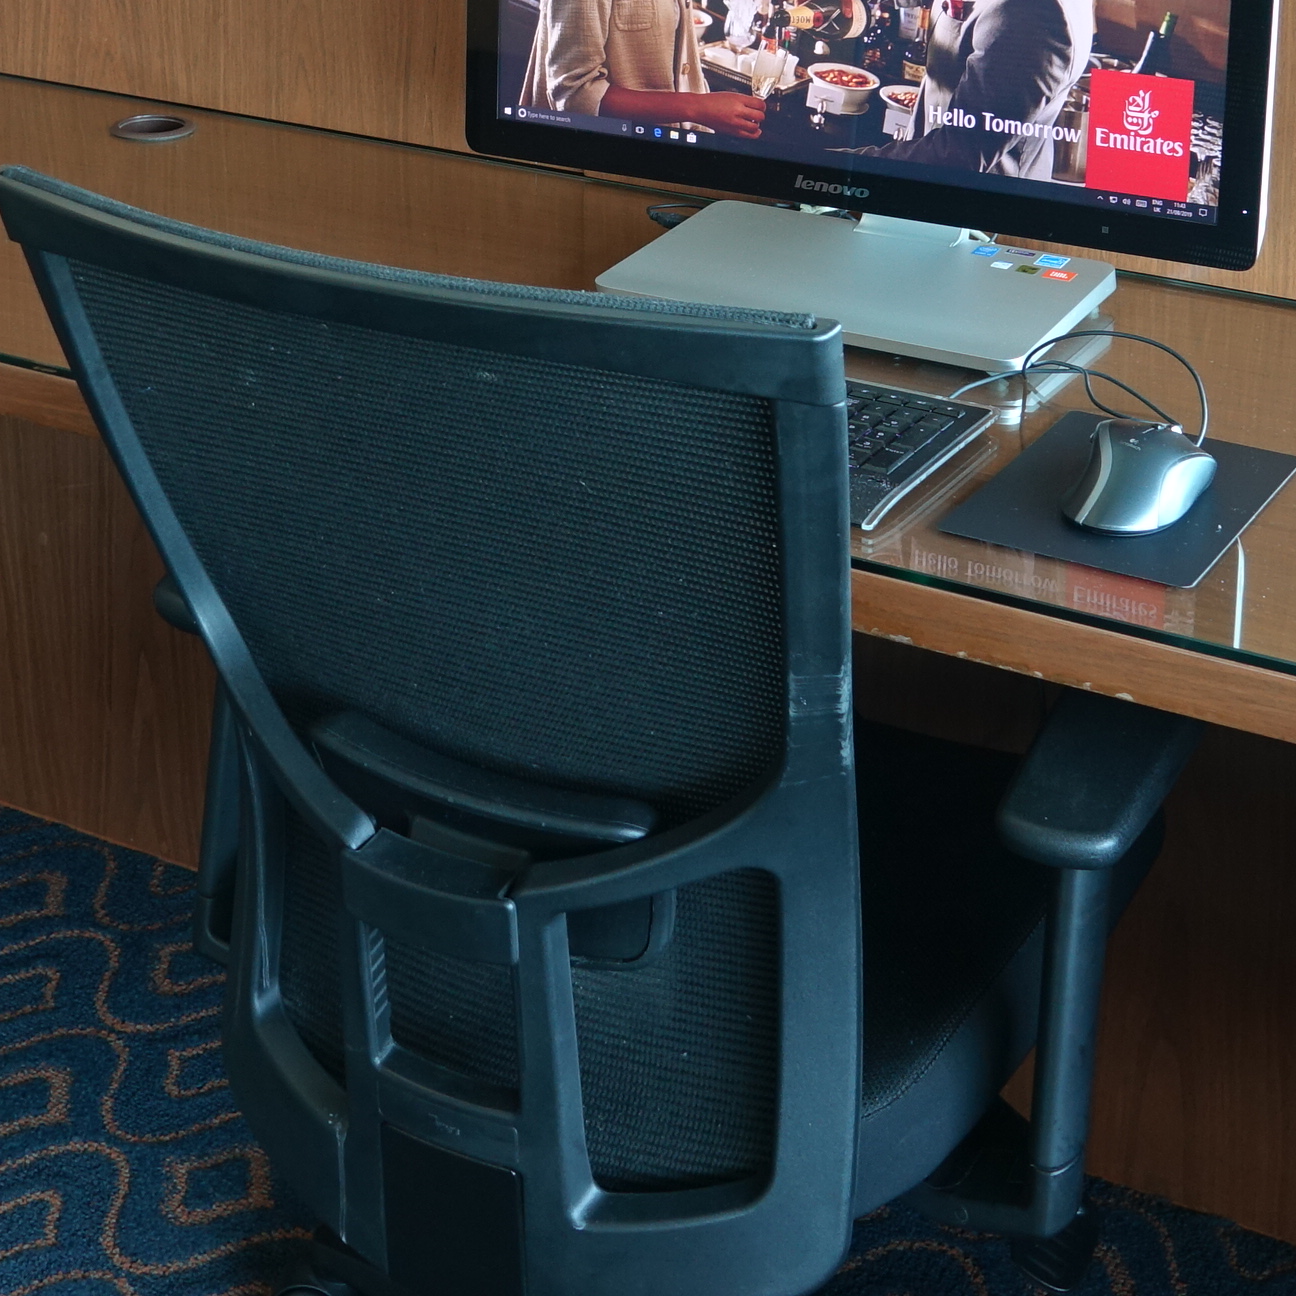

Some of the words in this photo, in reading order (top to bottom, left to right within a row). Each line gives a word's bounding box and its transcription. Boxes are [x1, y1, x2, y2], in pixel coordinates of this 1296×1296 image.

[527, 110, 539, 119] Type
[929, 104, 976, 130] Hello
[981, 111, 1082, 144] Tomorrow
[1095, 127, 1184, 157] Emirates
[793, 174, 871, 200] lenovo
[1151, 199, 1163, 207] ENG
